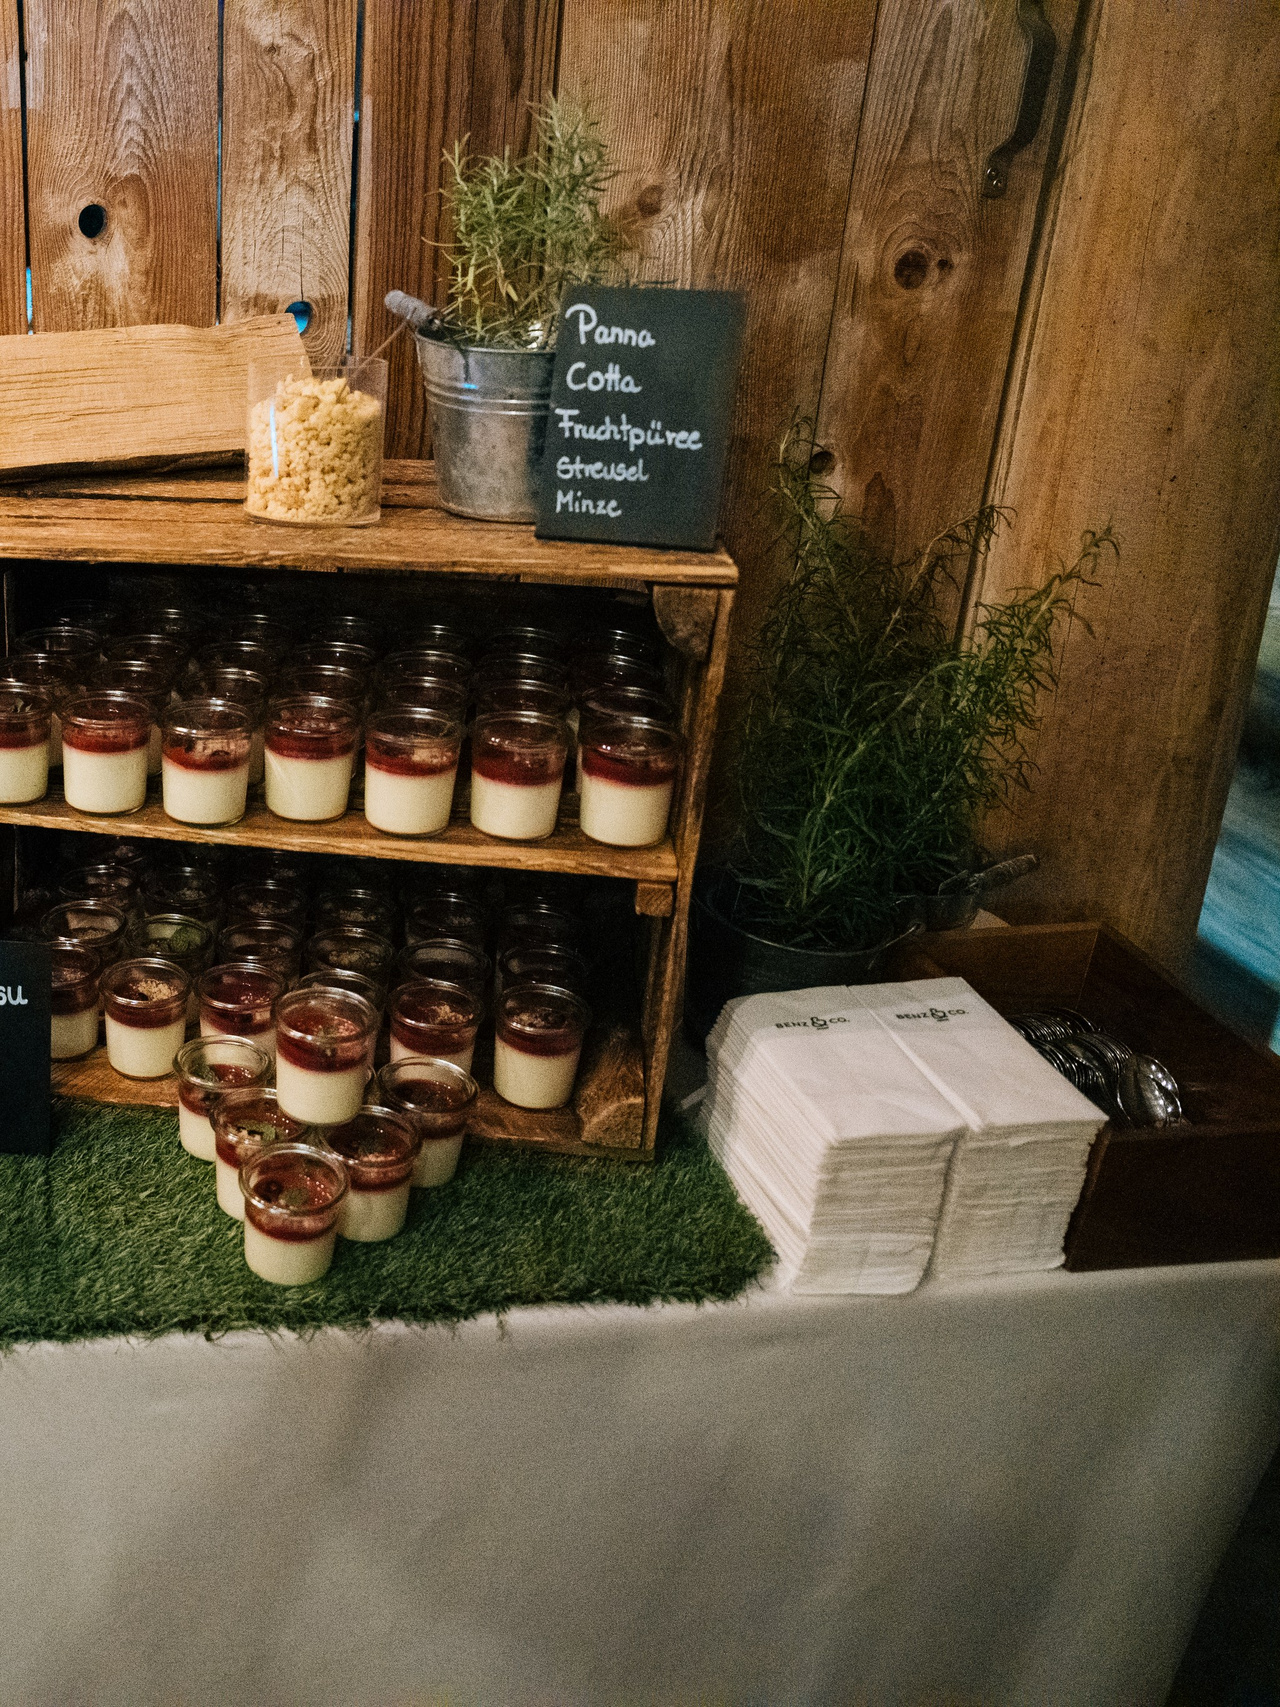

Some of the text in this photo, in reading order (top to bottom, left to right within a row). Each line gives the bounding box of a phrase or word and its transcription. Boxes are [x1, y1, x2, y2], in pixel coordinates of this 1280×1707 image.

[565, 303, 656, 348] Panna
[566, 361, 642, 393] Cotta
[554, 408, 703, 451] Fruchtpüree
[556, 456, 649, 481] Streusel
[555, 489, 622, 517] Minze
